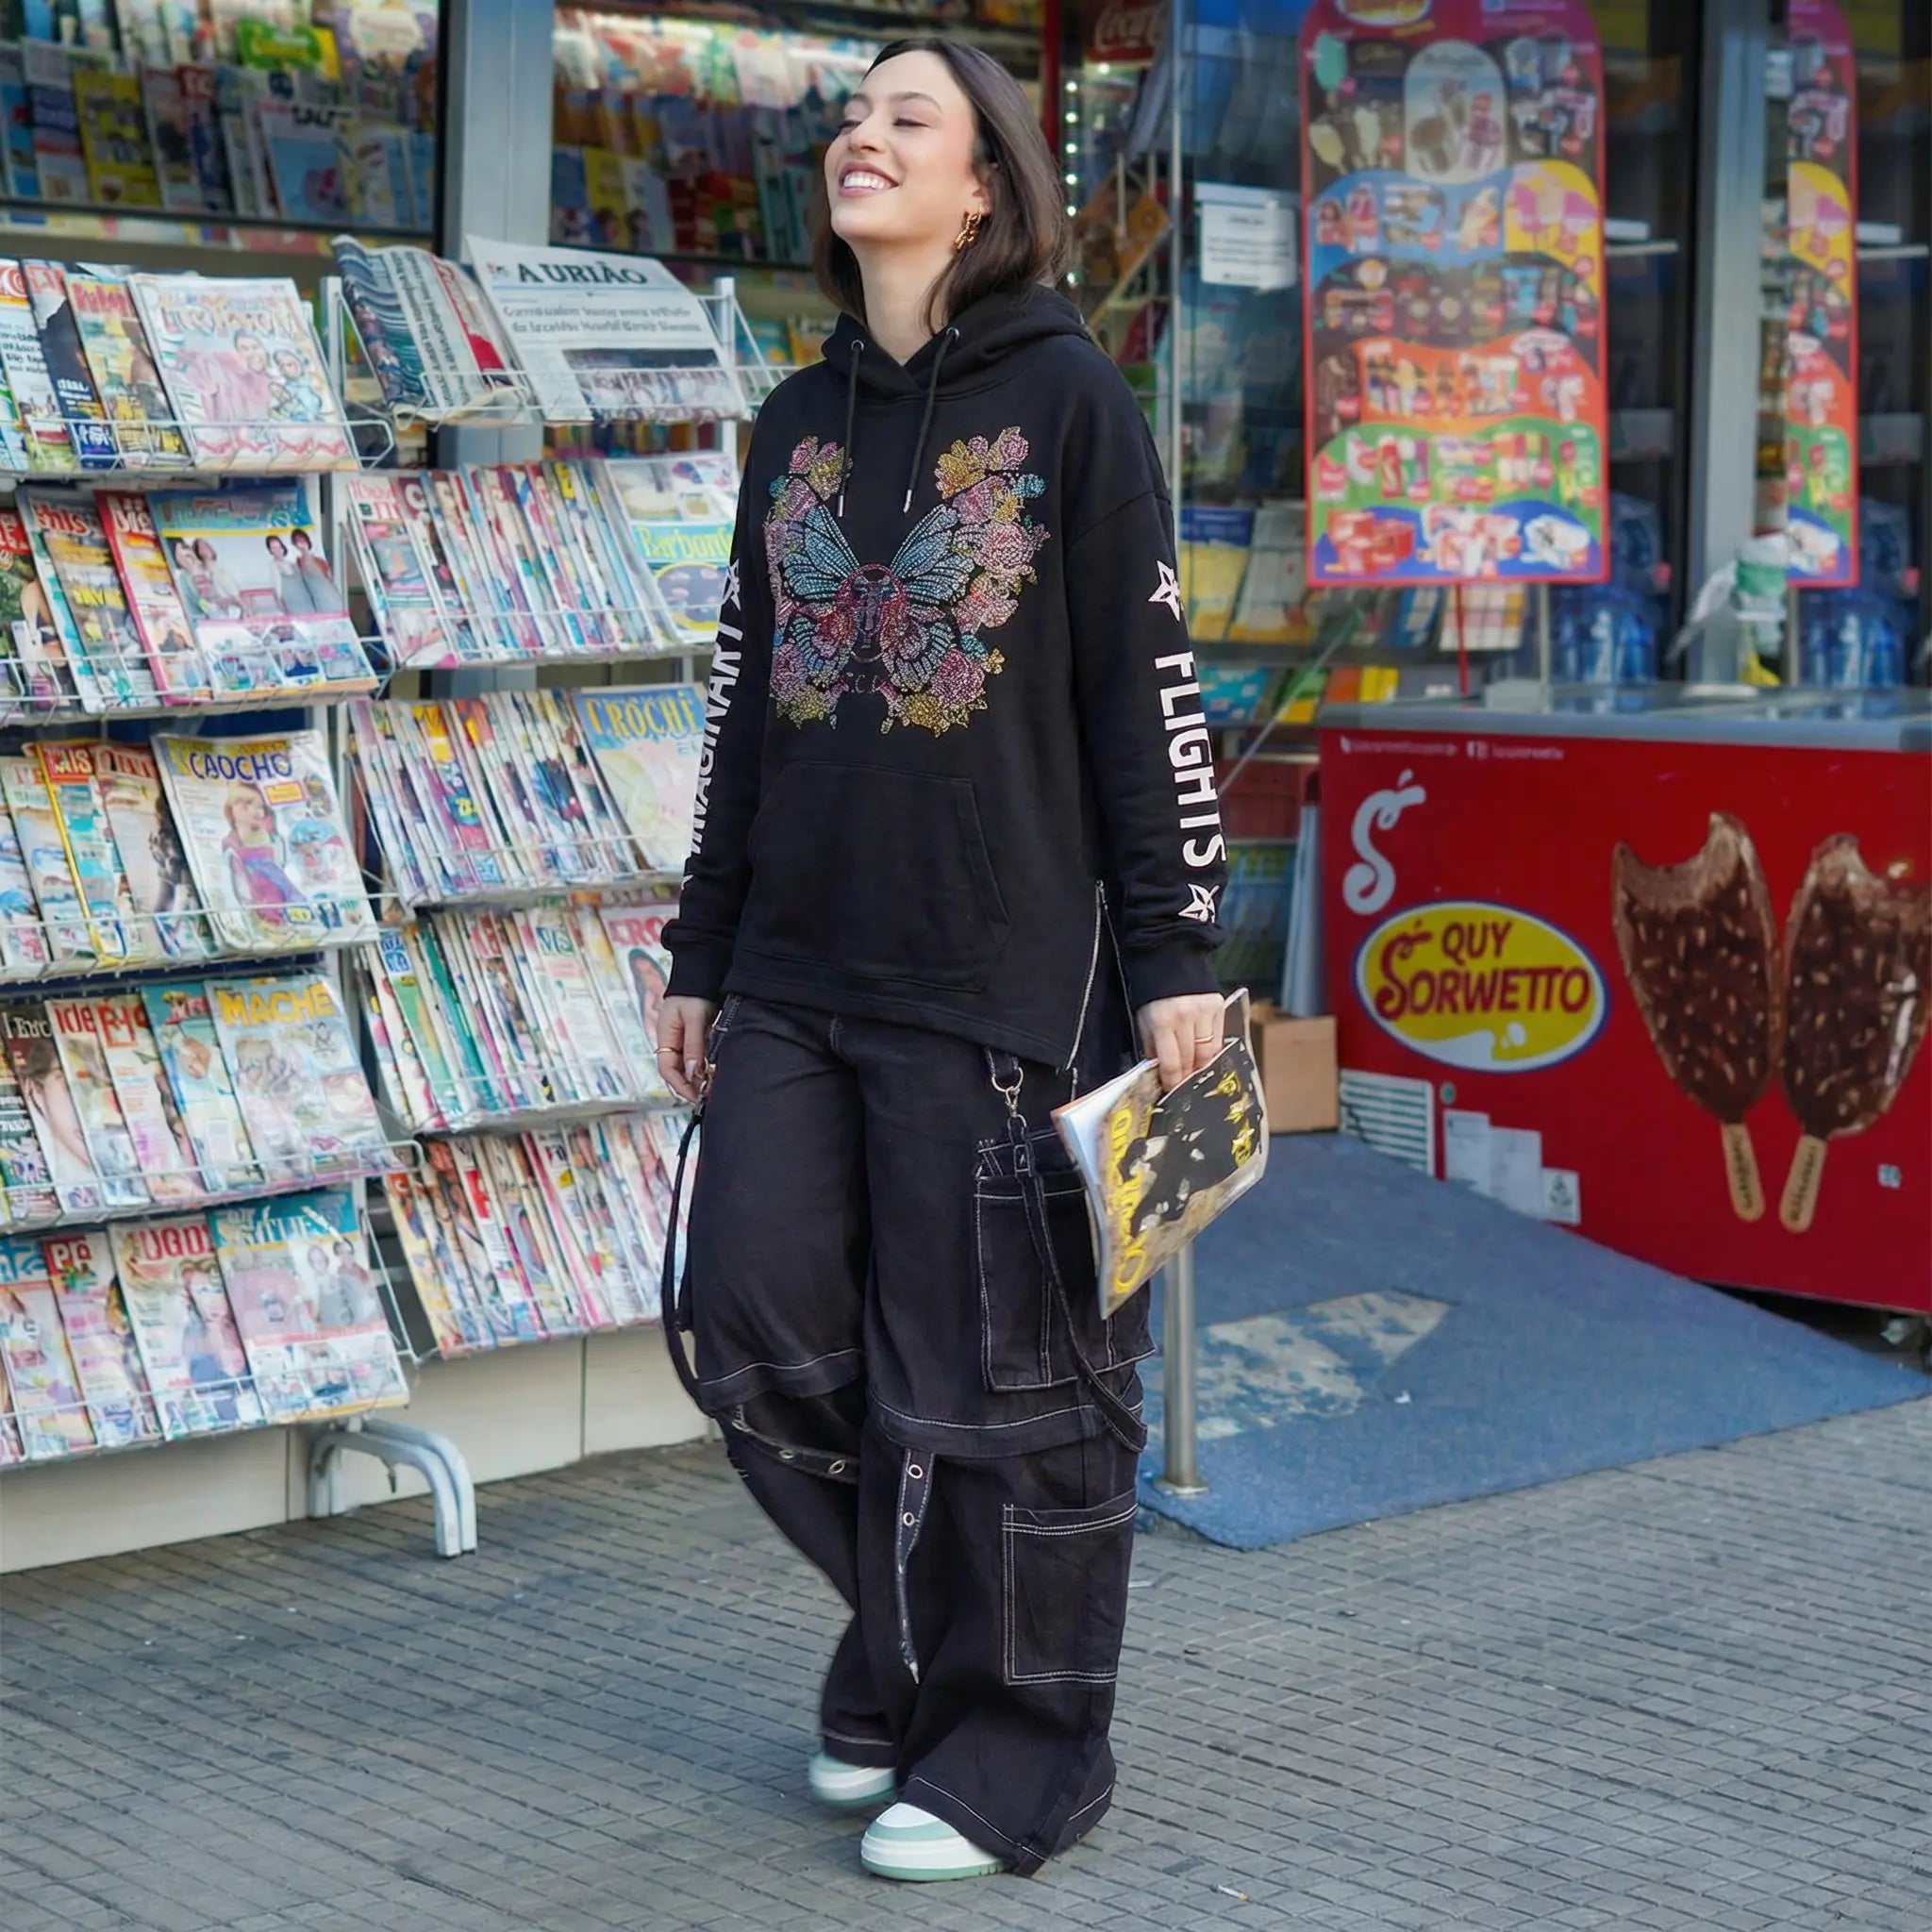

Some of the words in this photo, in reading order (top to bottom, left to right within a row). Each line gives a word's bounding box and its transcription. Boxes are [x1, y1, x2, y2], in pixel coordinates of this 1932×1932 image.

[518, 263, 544, 283] A
[1154, 651, 1227, 868] FLIGHTS
[1374, 919, 1591, 1023] SORWETTO
[1441, 921, 1513, 966] QUY
